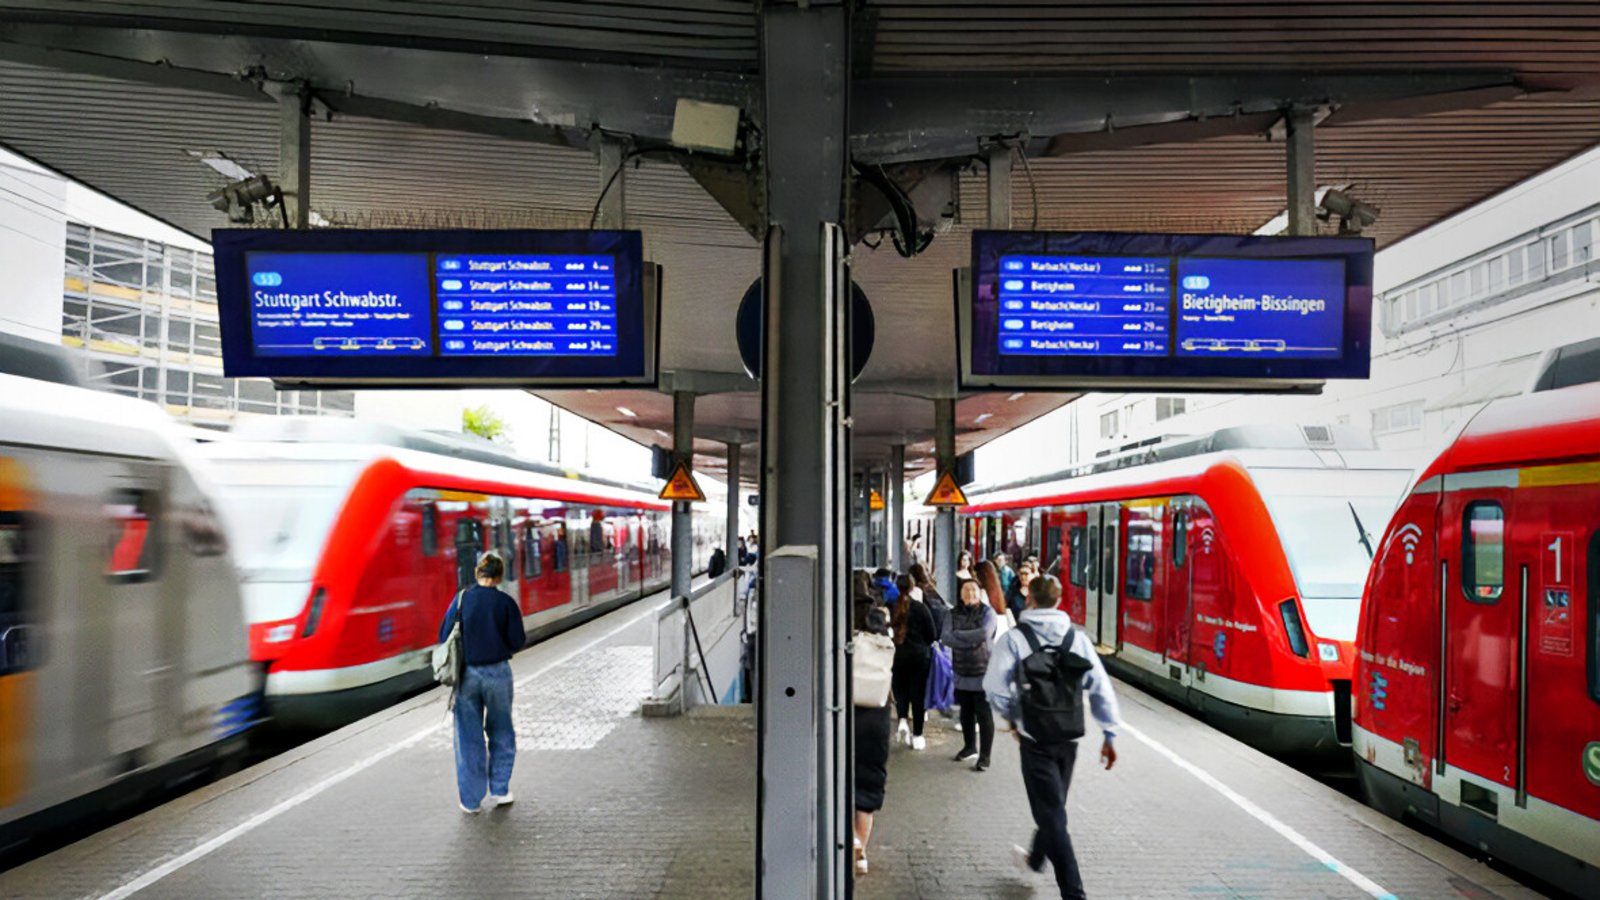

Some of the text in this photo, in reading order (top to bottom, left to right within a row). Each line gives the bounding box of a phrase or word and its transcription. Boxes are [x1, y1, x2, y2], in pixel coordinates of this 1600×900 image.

[468, 260, 506, 272] Stuttgart
[469, 280, 507, 292] Stuttgart
[254, 290, 402, 311] Stuttgart Schwabstr.
[470, 300, 508, 312] Stuttgart
[1182, 293, 1326, 316] Bietigheim-Bissingen
[471, 320, 508, 332] Stuttgart
[472, 340, 509, 352] Stuttgart
[1547, 536, 1561, 583] 1
